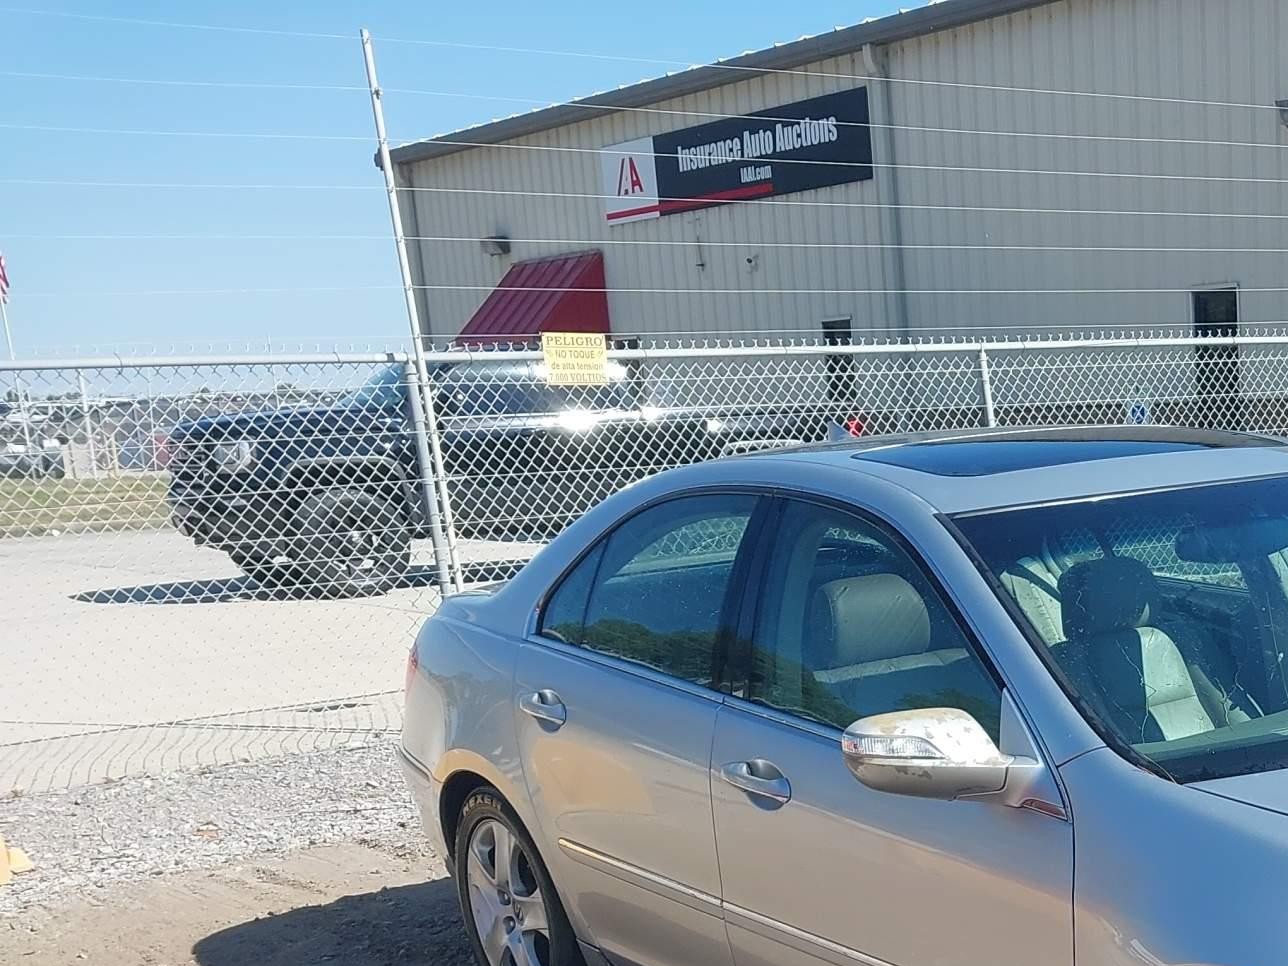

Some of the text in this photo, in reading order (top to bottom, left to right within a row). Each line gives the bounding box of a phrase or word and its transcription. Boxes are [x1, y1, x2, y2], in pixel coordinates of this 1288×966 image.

[677, 116, 839, 173] Insurance Auto Auctions
[546, 335, 603, 346] PELIGRO
[555, 349, 595, 359] NO TOQUE
